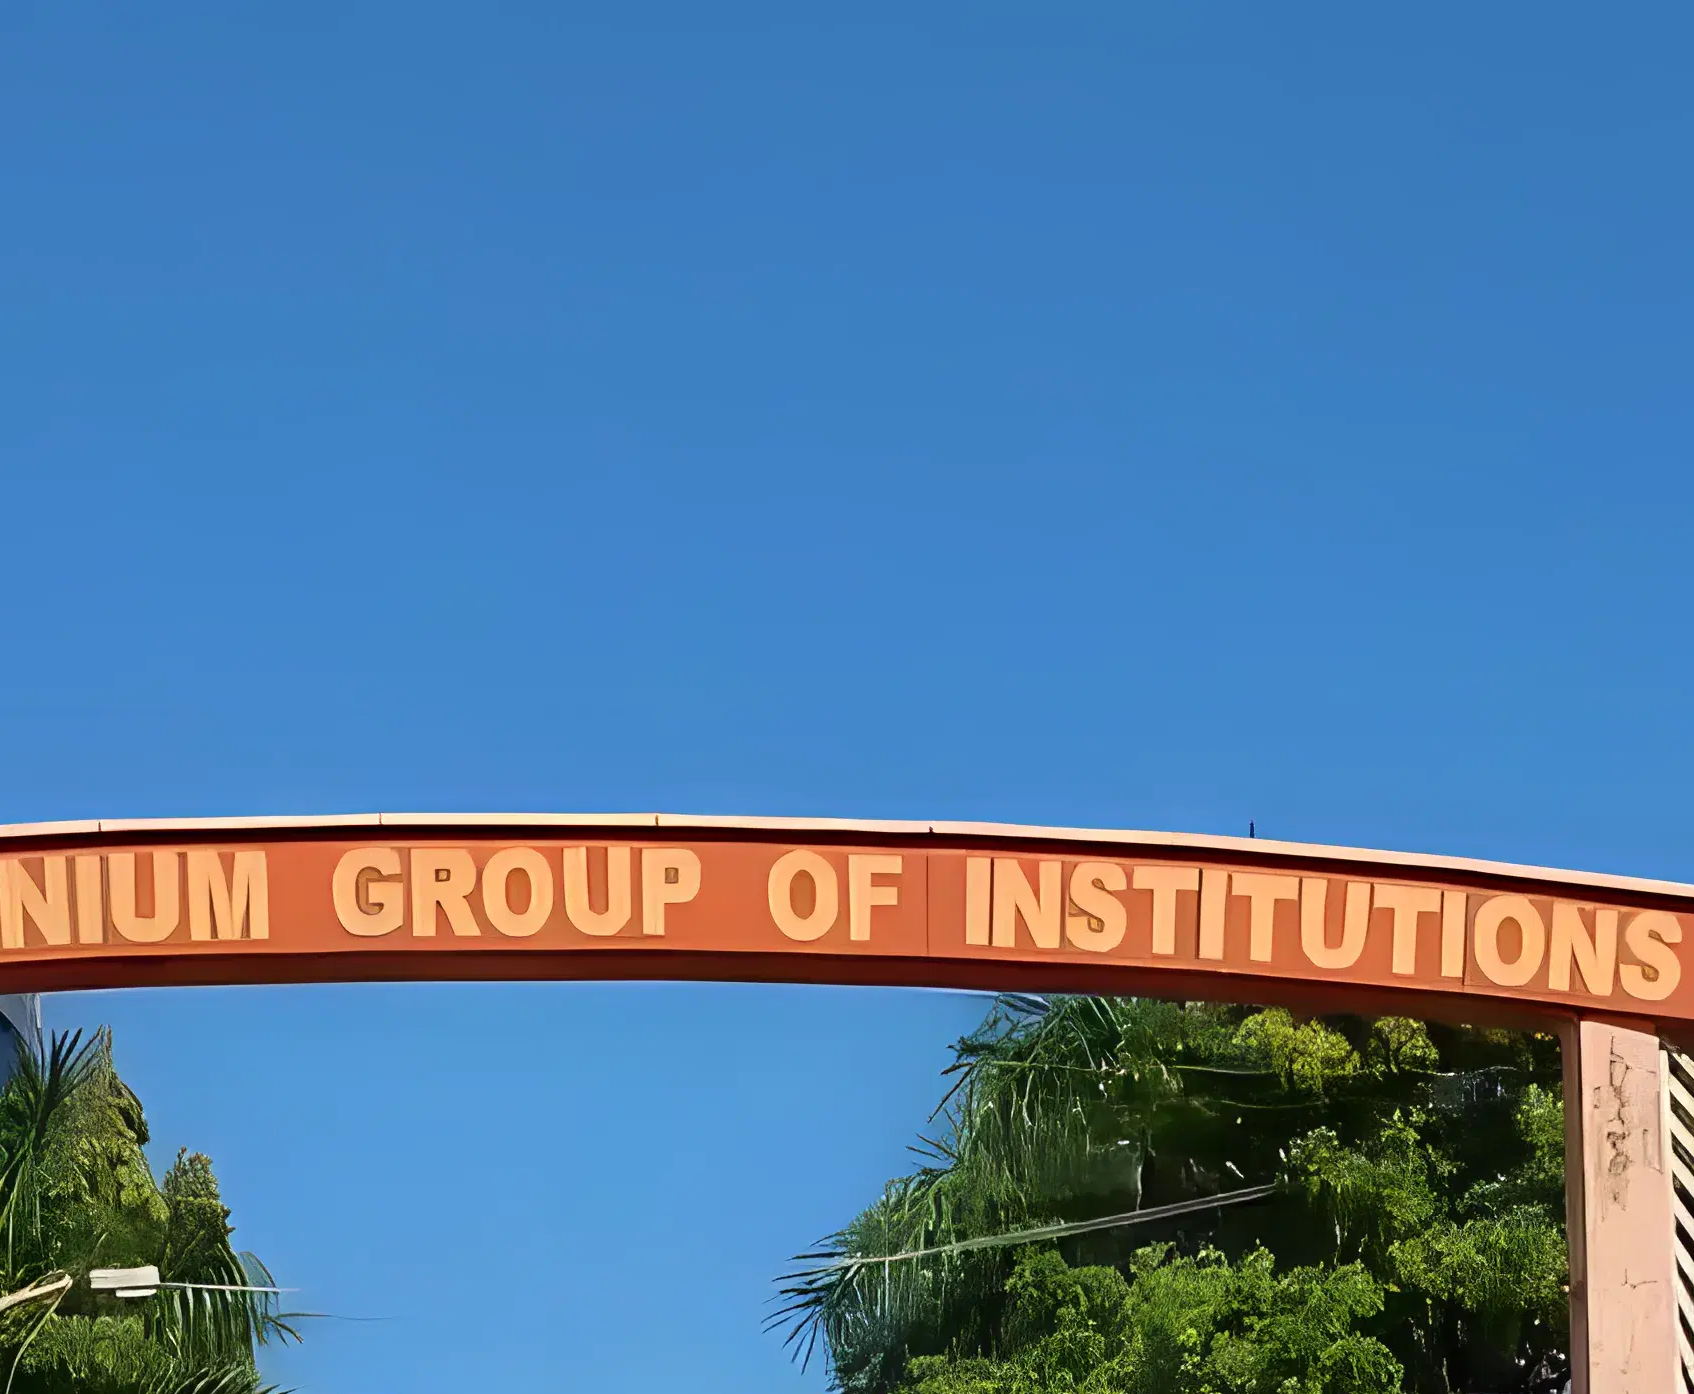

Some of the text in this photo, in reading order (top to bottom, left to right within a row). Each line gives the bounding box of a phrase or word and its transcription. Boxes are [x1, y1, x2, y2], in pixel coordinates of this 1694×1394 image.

[332, 846, 702, 938] GROUP
[767, 849, 903, 942] OF
[964, 856, 1684, 1001] INSTITUTIONS
